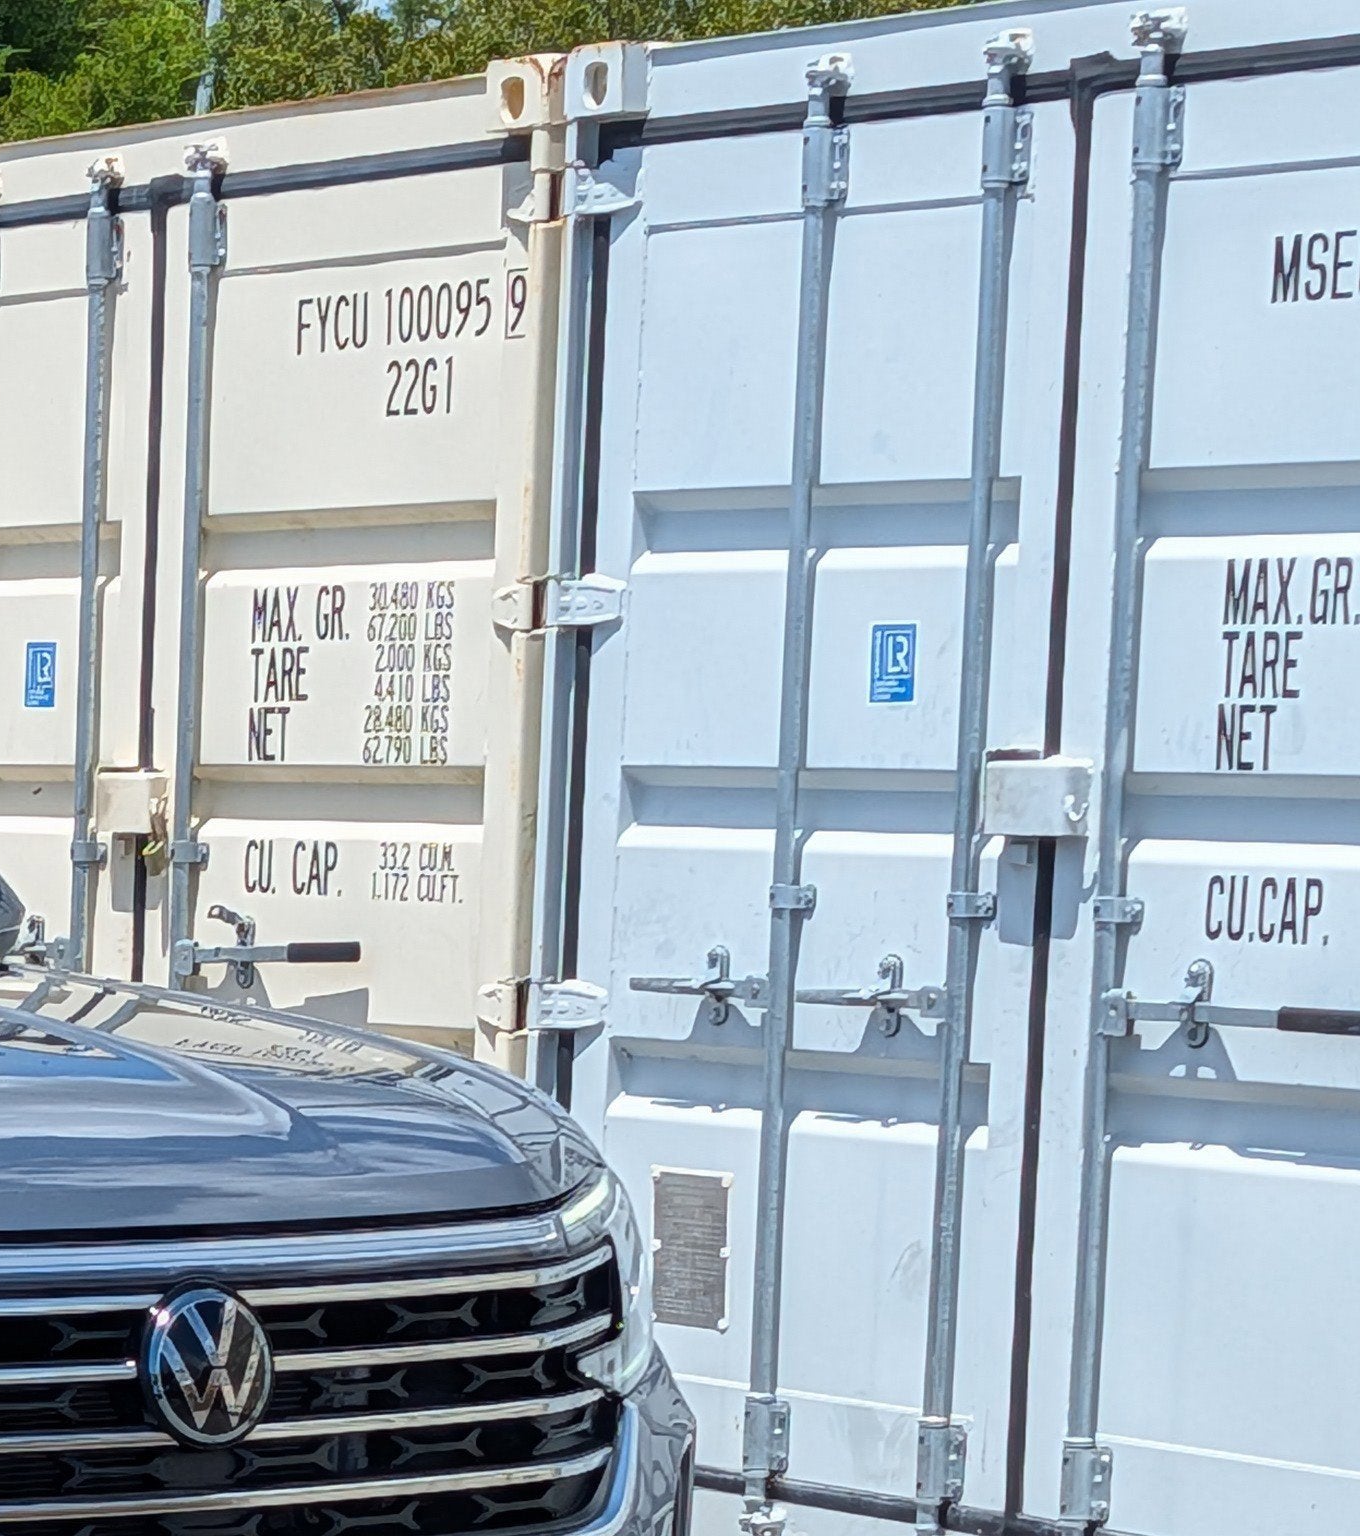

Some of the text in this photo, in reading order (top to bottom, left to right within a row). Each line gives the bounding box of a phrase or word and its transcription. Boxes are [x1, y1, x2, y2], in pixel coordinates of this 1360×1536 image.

[1270, 229, 1360, 304] MSE
[296, 273, 528, 356] FYCU 100095 9
[385, 354, 454, 417] 22G1
[250, 585, 302, 644] MAX.
[315, 584, 350, 641] GR.
[425, 579, 455, 610] KGS
[424, 611, 454, 641] LBS
[250, 646, 310, 703] TARE
[422, 642, 452, 672] KGS
[421, 673, 451, 703] LBS
[1222, 630, 1304, 699] TARE
[247, 706, 291, 762] NET
[419, 703, 450, 734] KGS
[419, 735, 449, 766] LBS
[1215, 702, 1278, 771] NET
[244, 839, 277, 895] CU.
[291, 839, 343, 898] CAP.
[154, 1292, 267, 1436] VW
